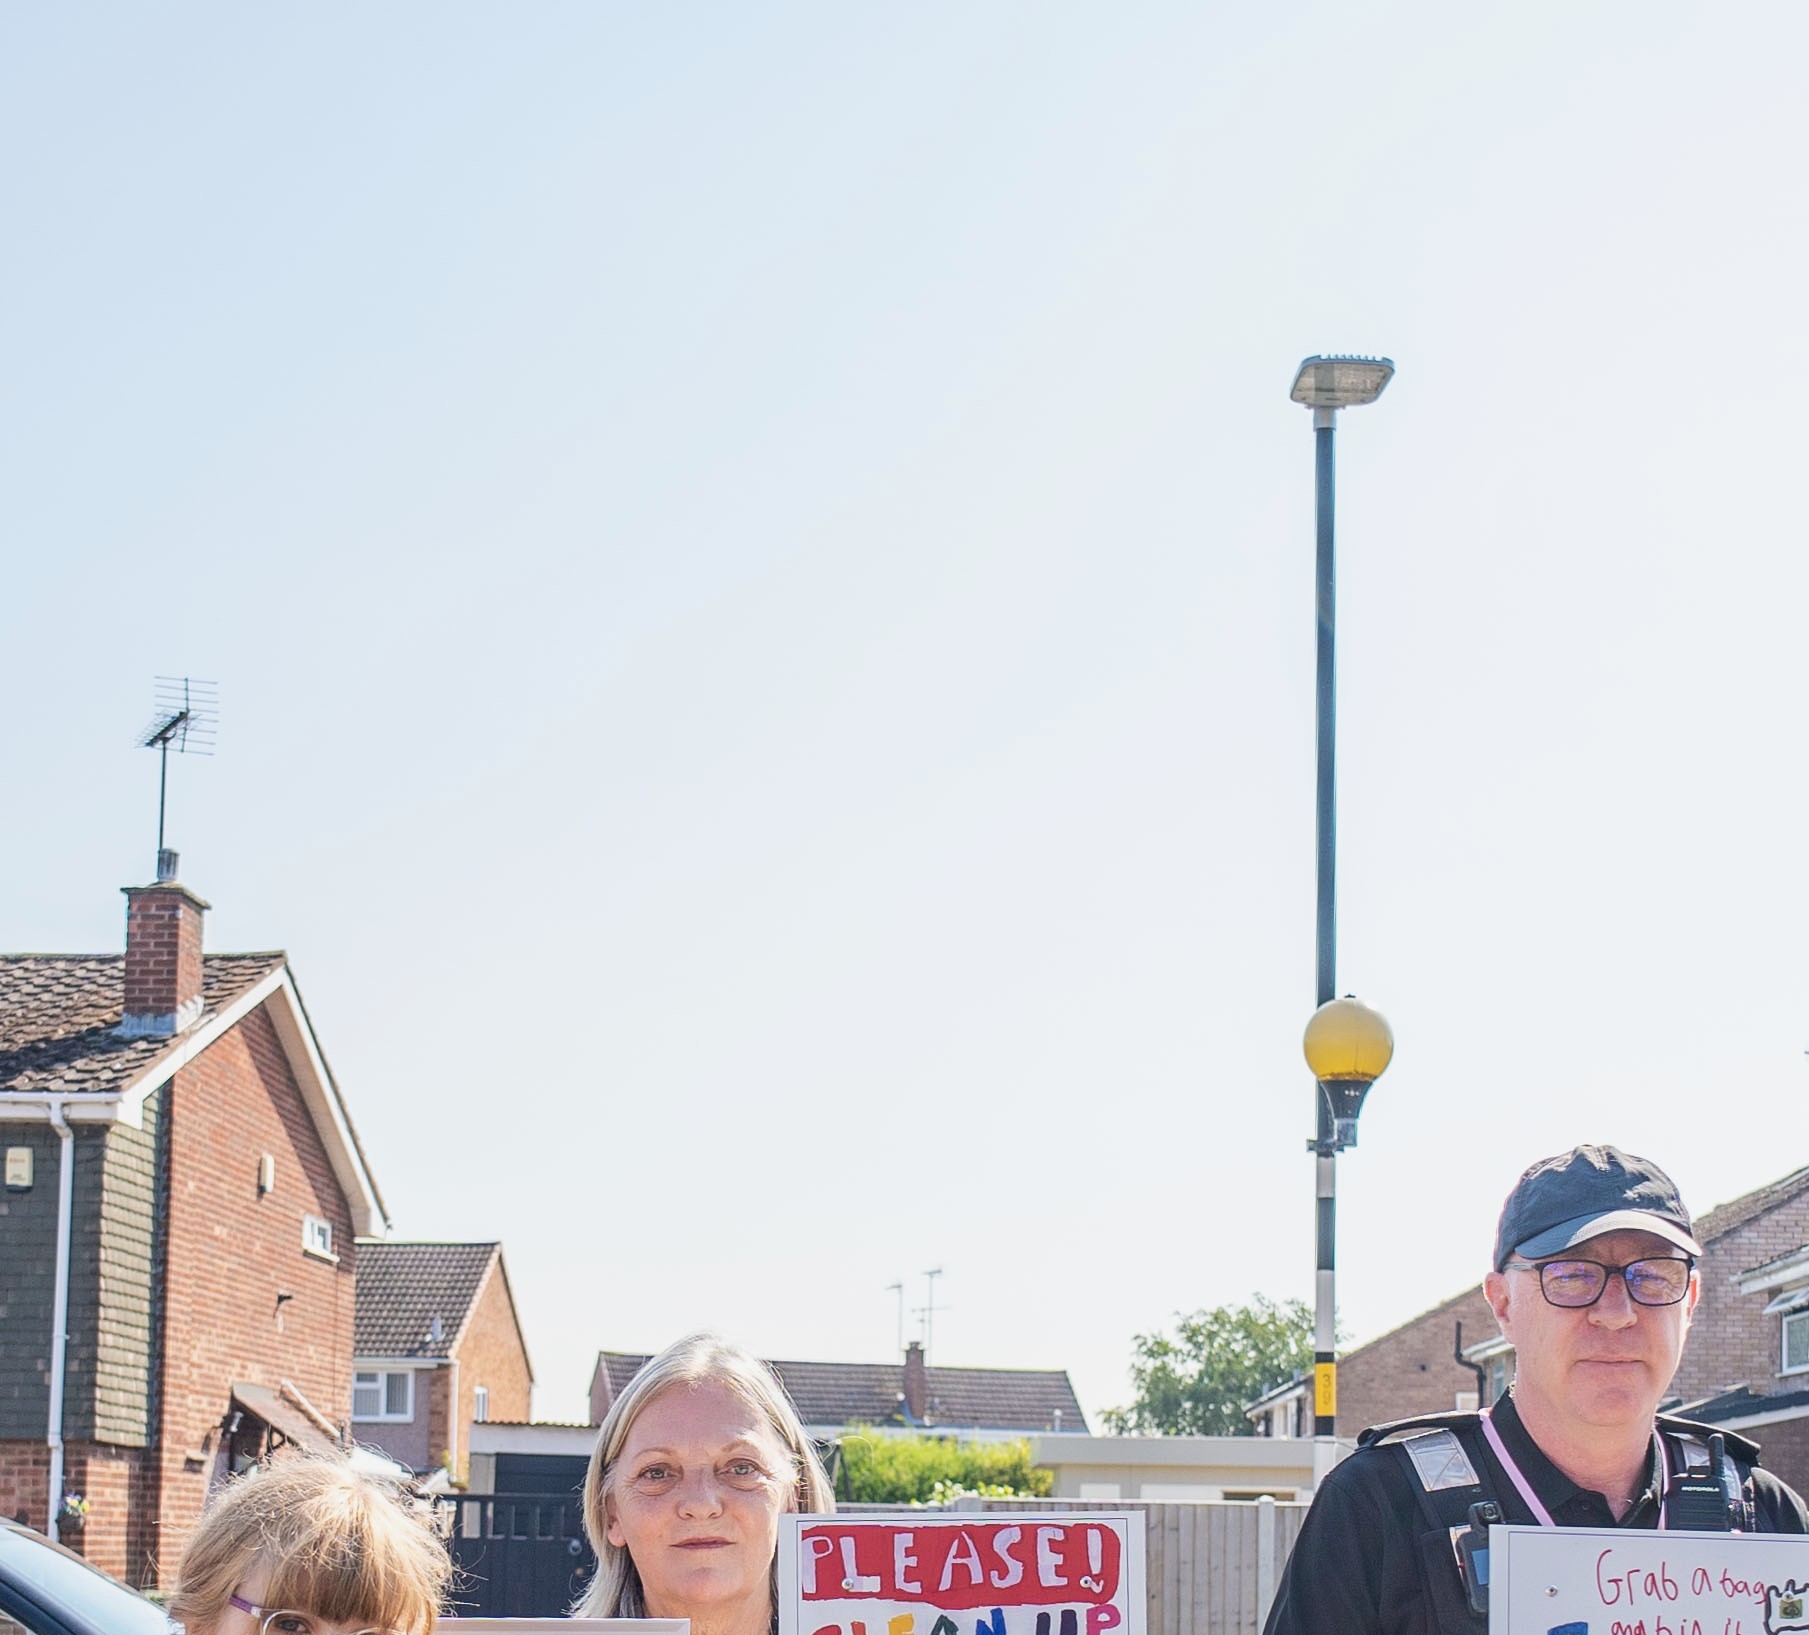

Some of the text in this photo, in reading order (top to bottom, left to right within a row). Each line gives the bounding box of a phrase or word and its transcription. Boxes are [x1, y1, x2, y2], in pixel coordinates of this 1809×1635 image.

[802, 1527, 1105, 1595] PLEASE!
[1596, 1549, 1679, 1605] Grab
[1719, 1567, 1769, 1605] bag
